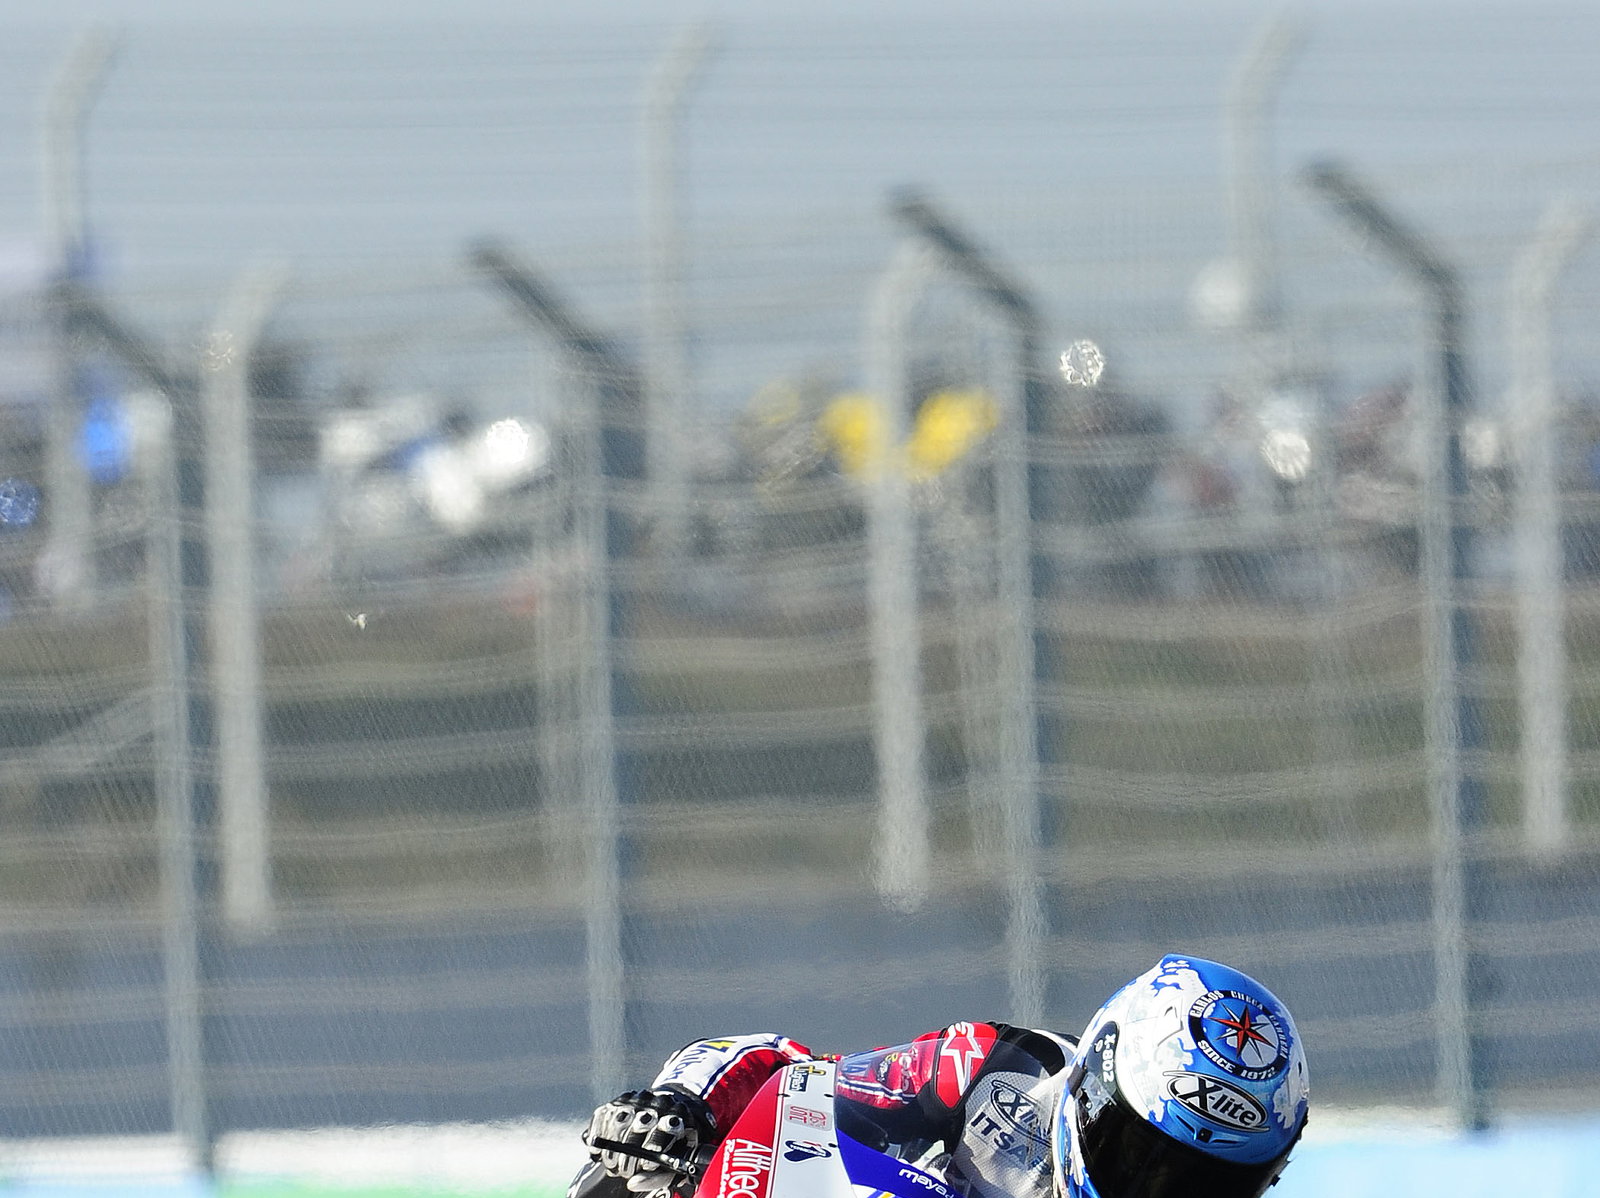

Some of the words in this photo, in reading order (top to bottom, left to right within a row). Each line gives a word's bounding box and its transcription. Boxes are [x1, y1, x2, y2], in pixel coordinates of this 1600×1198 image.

[1189, 990, 1224, 1018] CARLOS
[1102, 1033, 1116, 1082] X-802
[1197, 1040, 1236, 1074] SINCE
[1176, 1075, 1257, 1126] X-lite
